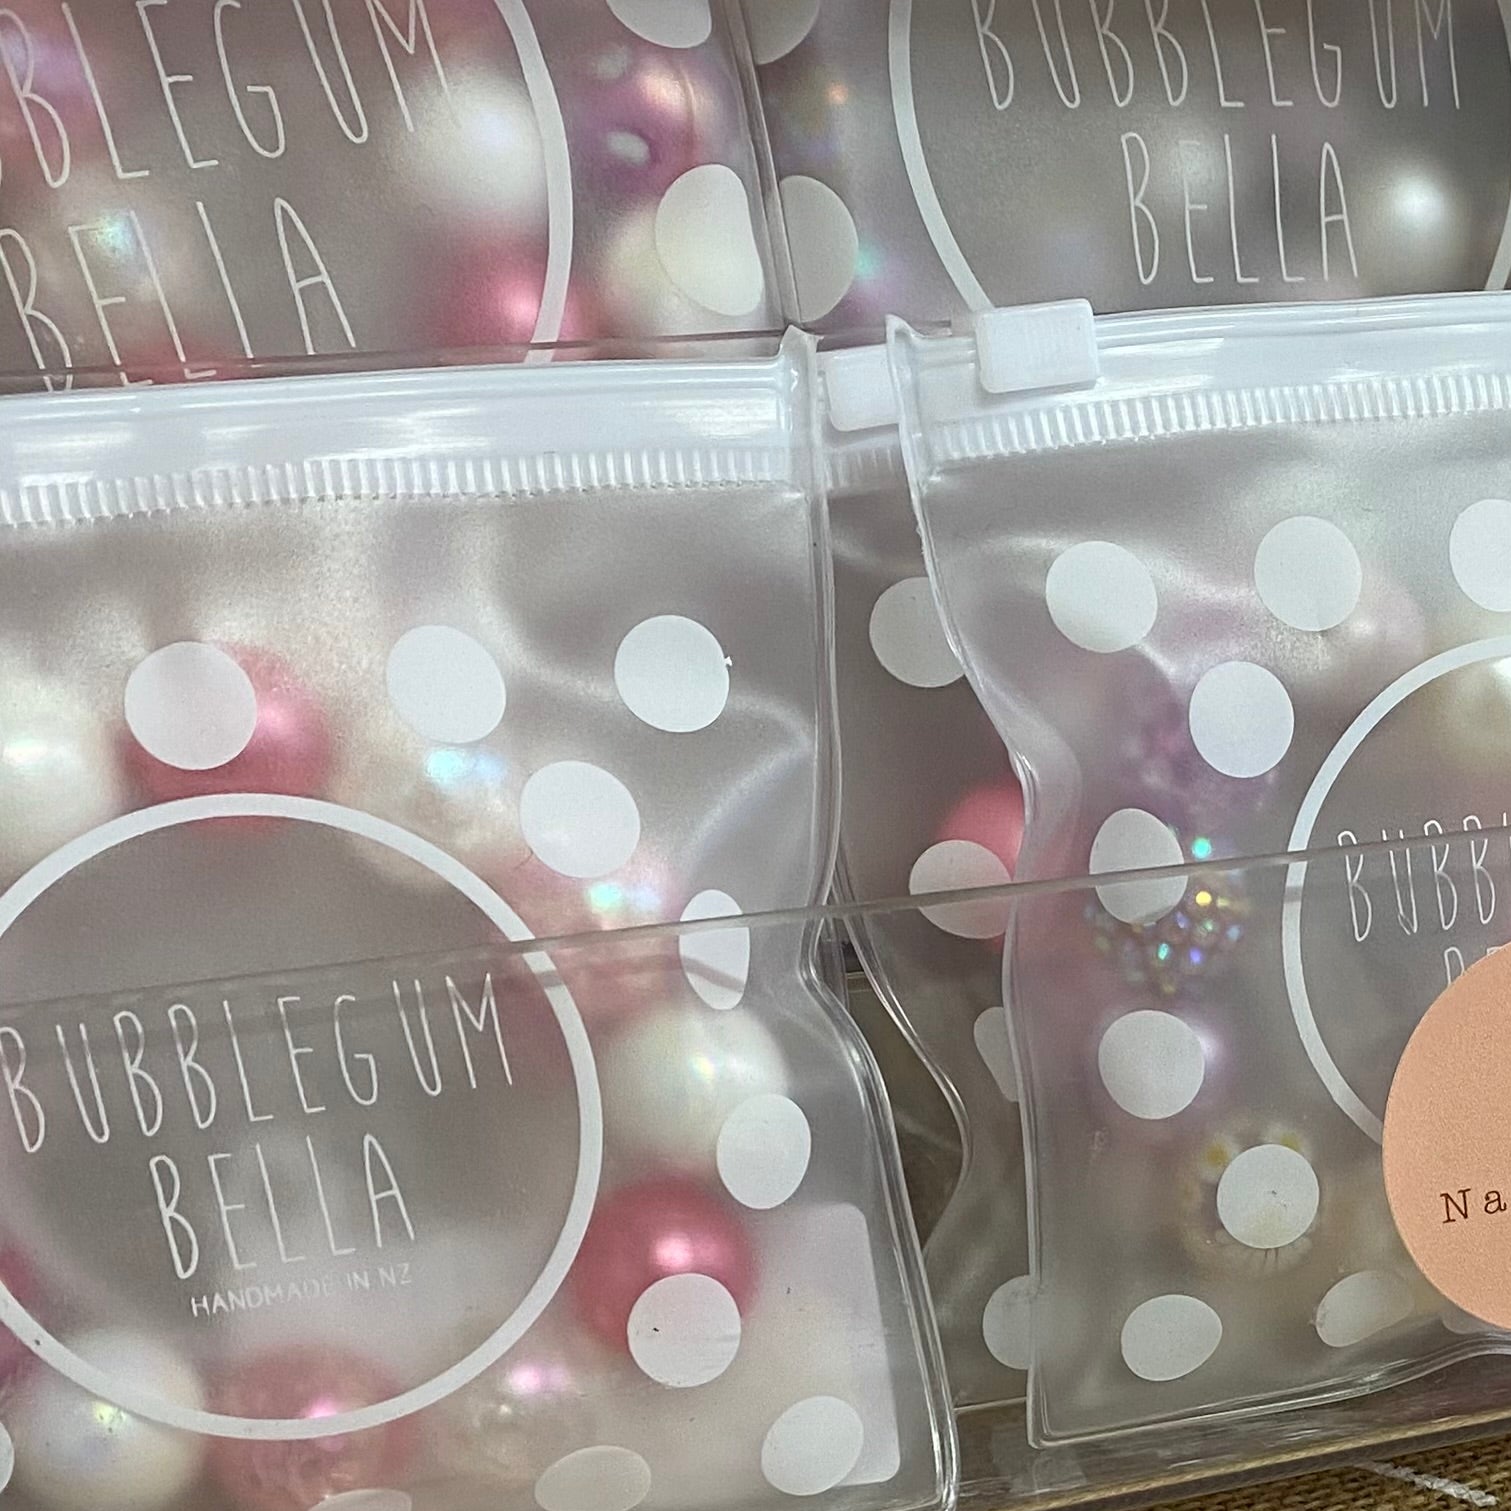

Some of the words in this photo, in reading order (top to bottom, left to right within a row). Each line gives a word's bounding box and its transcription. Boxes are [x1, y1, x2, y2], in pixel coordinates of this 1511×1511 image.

[971, 0, 1461, 110] BUBBLEGUM
[1121, 131, 1359, 285] BELLA
[0, 972, 514, 1153] BUBBLEGUM
[149, 1132, 416, 1280] BELLA
[190, 1276, 337, 1318] HANDMADE
[346, 1270, 371, 1291] IN
[377, 1263, 413, 1289] NZ
